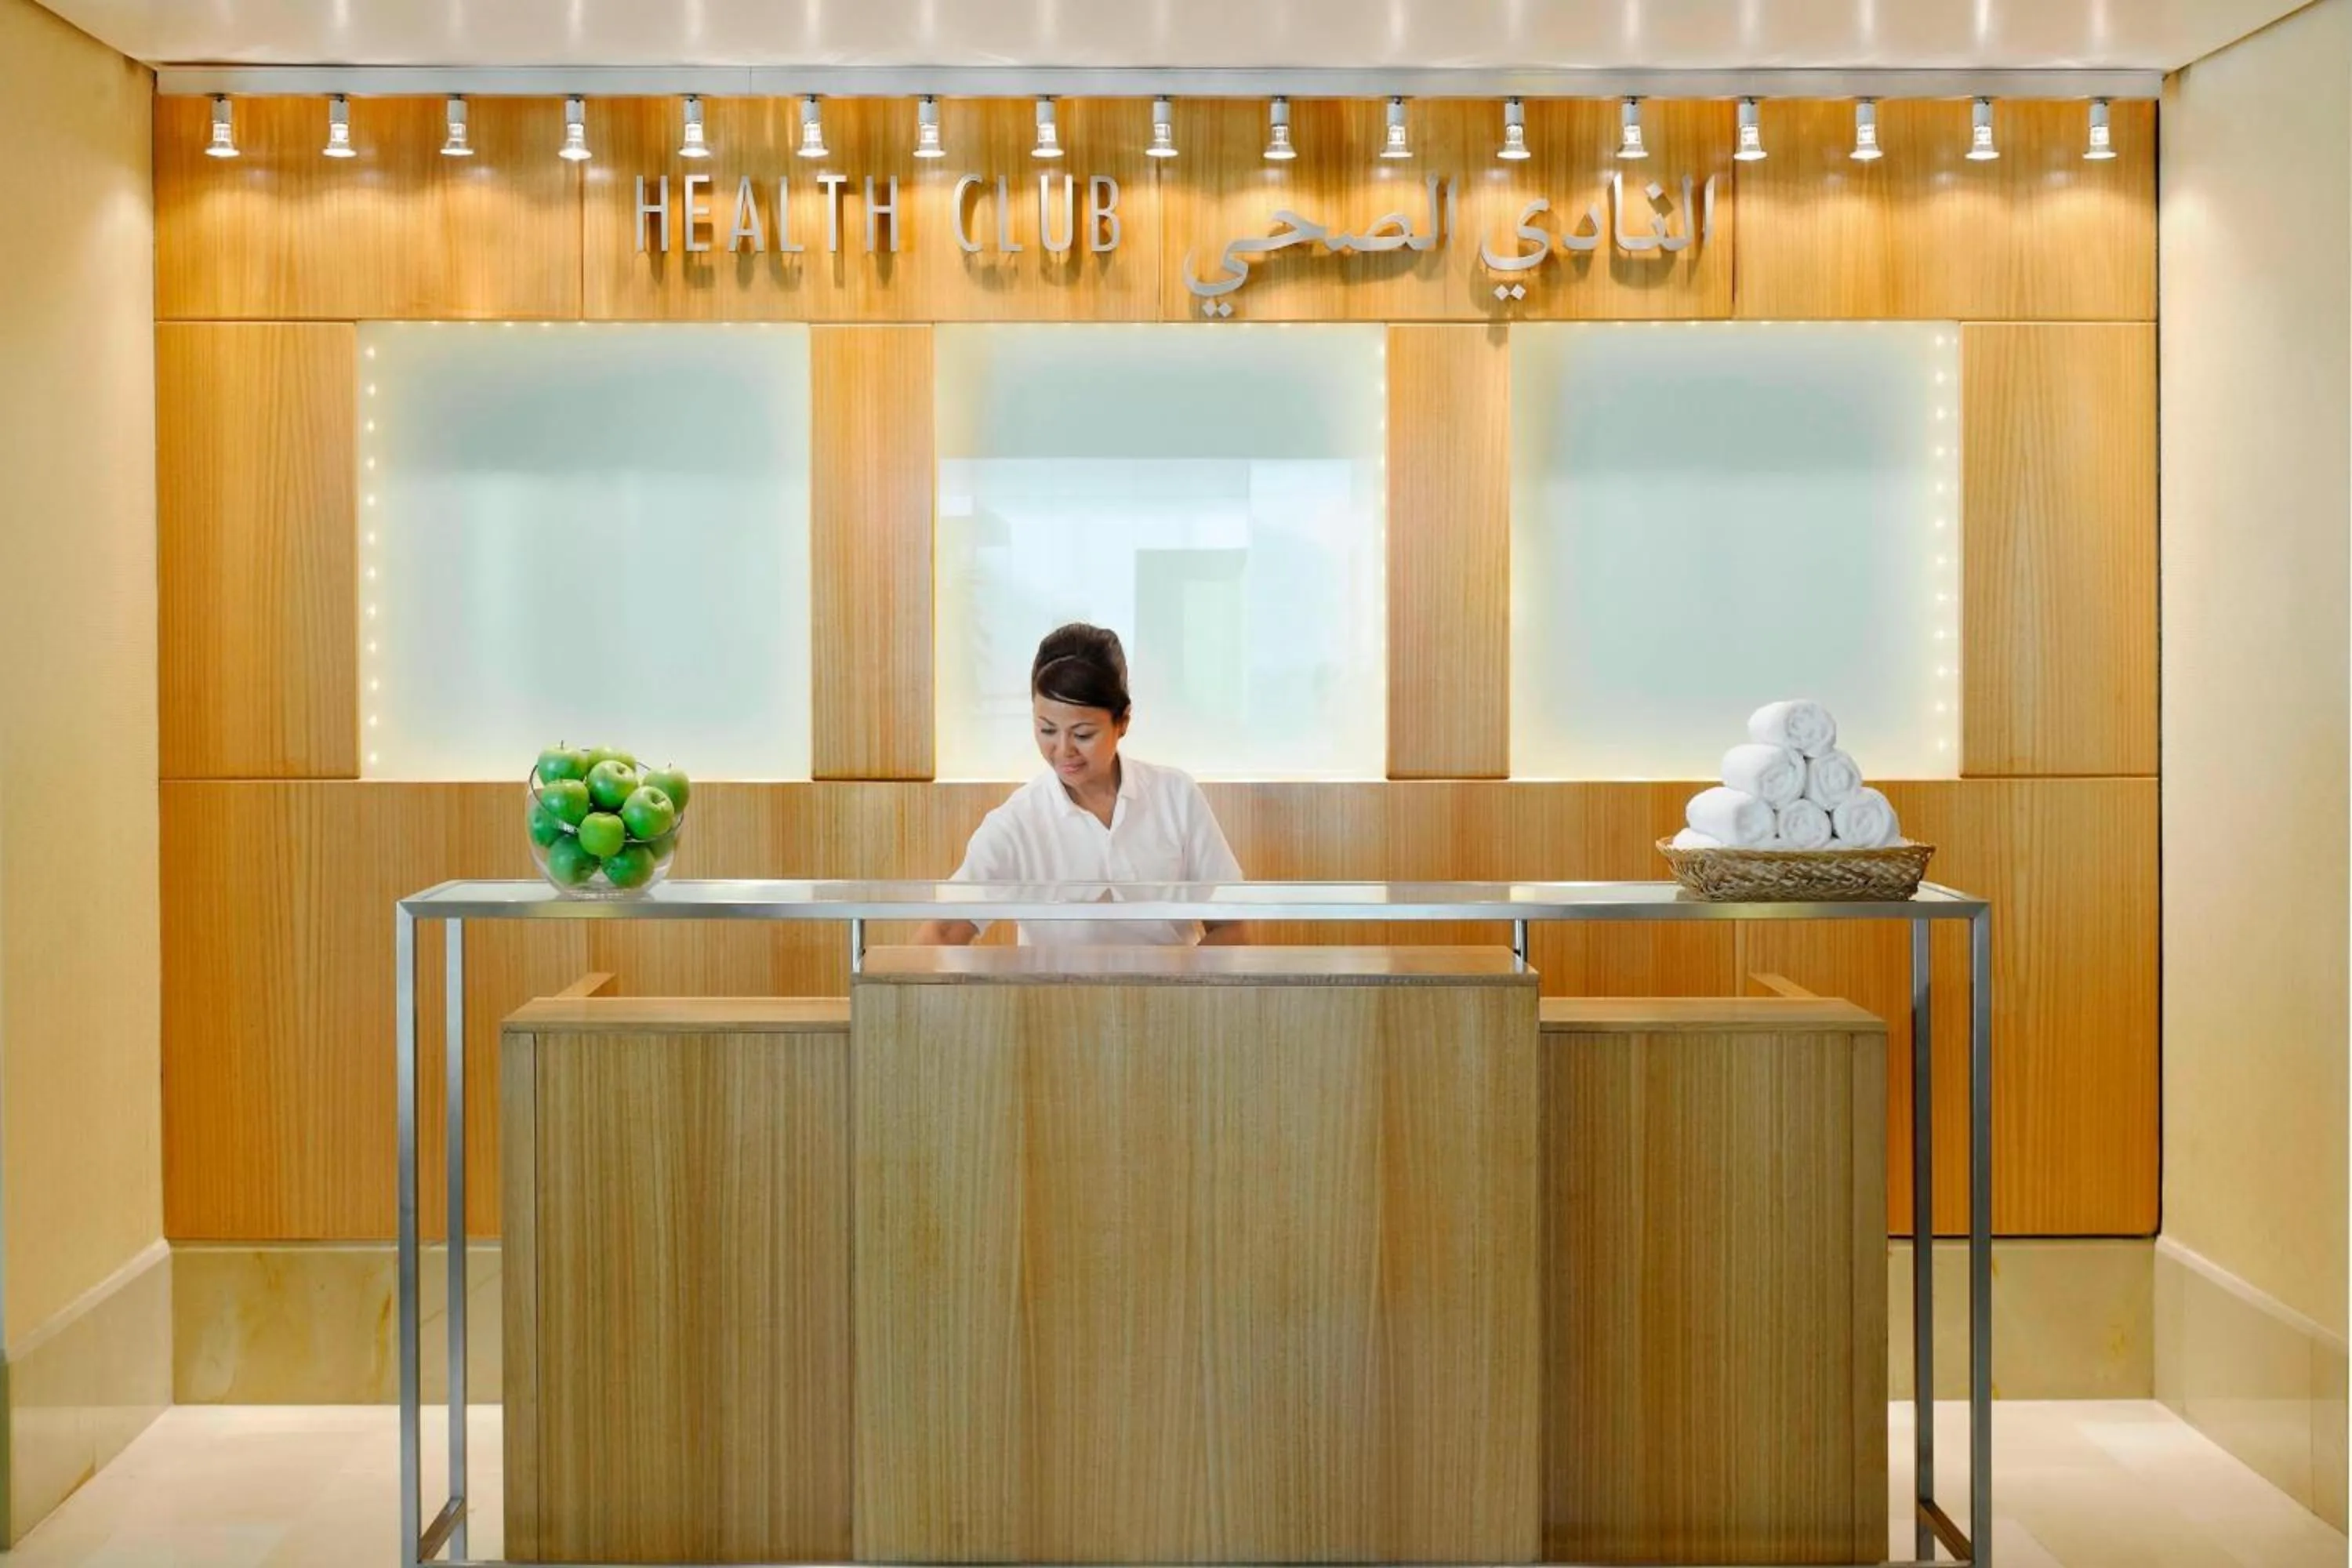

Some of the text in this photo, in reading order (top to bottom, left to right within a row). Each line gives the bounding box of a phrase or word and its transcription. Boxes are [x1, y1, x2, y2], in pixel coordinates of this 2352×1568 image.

[636, 174, 1120, 252] HEALTH CLUB
[1183, 172, 1715, 317] النادي الصحي
